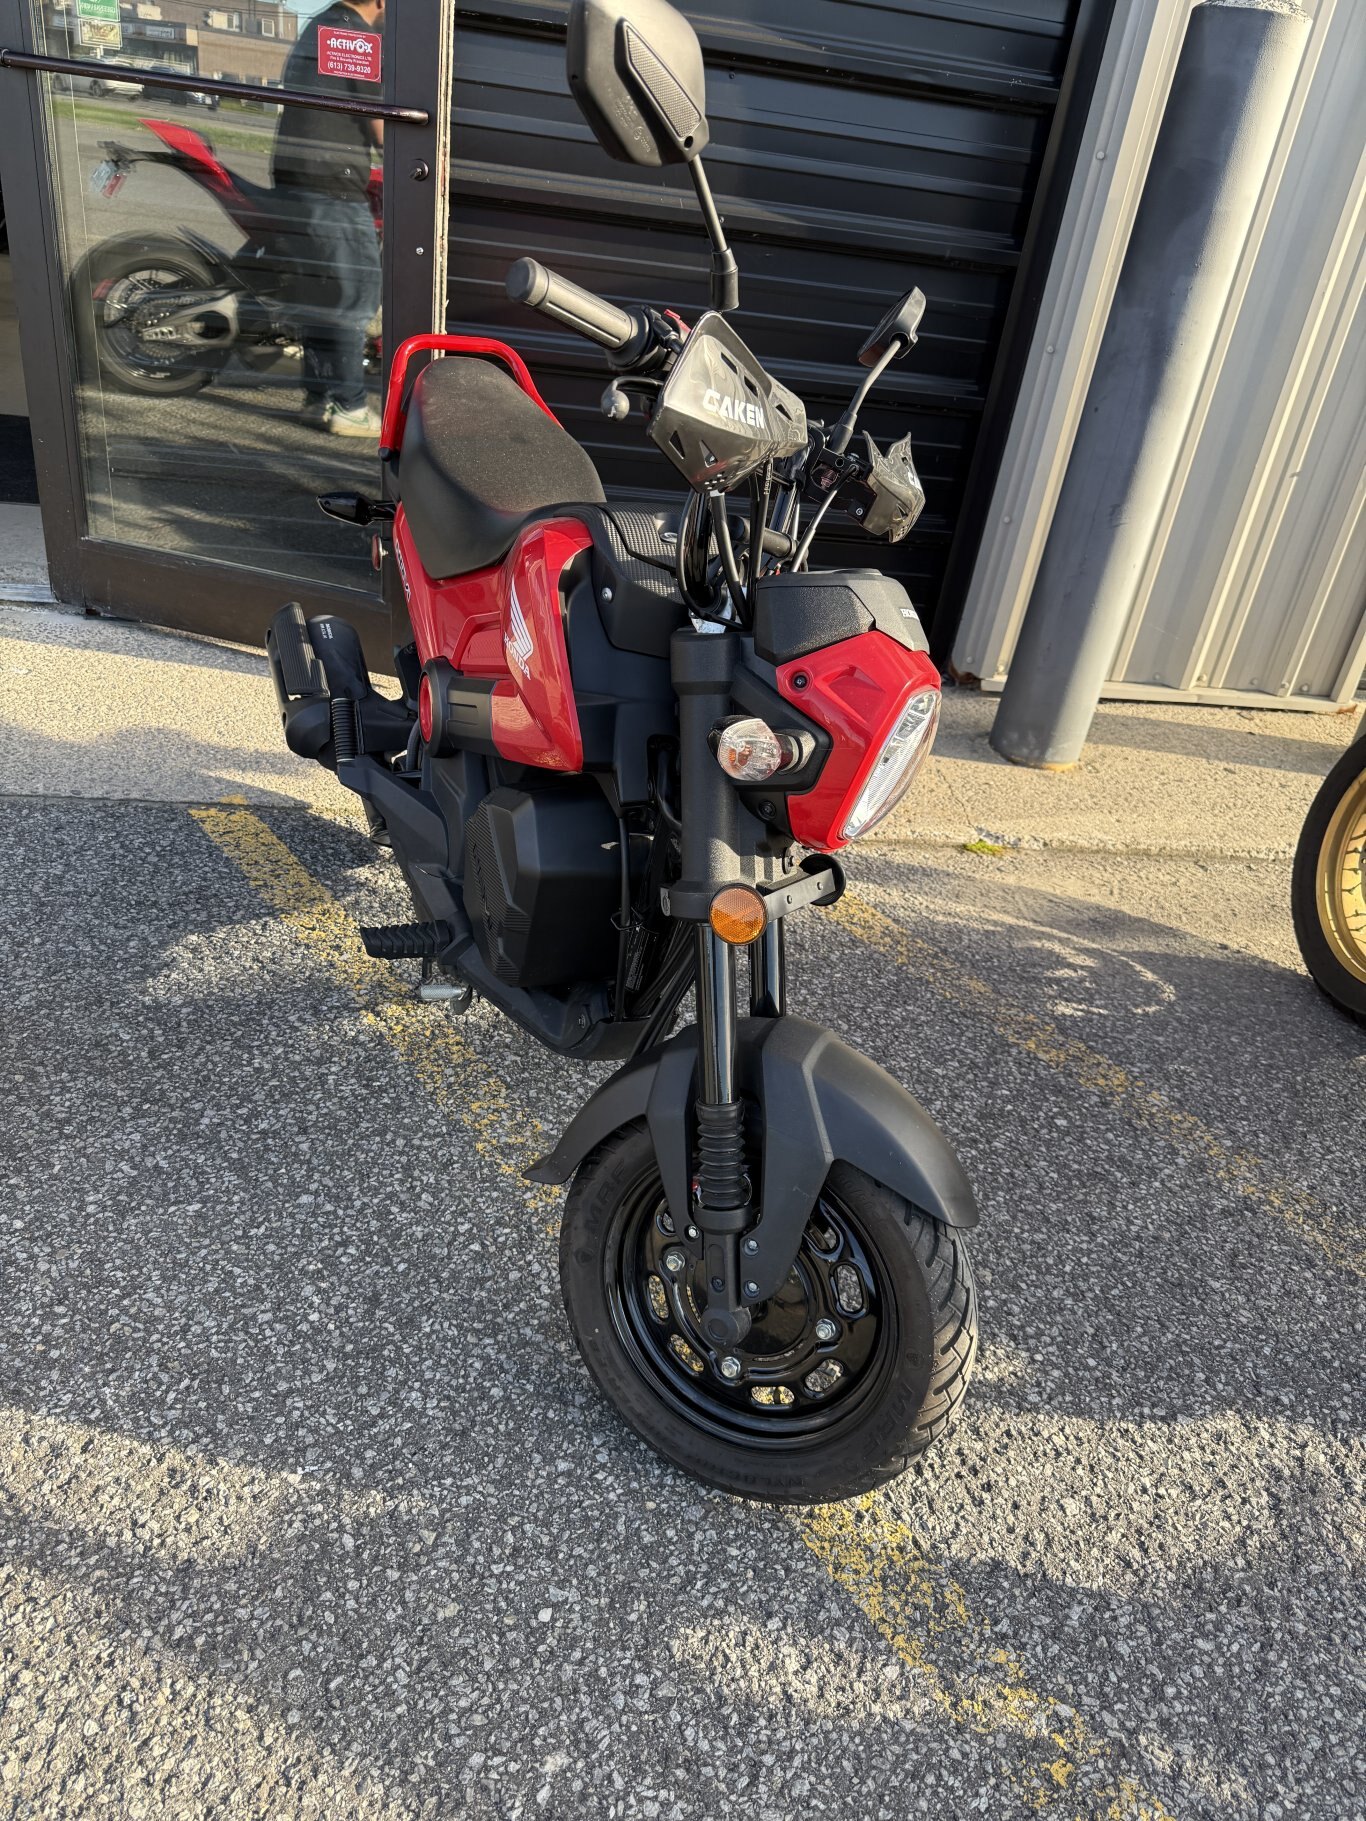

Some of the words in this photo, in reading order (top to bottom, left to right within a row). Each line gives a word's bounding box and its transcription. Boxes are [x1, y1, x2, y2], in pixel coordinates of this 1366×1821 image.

[327, 61, 343, 71] (613)
[344, 63, 371, 74] 739-9320
[900, 607, 920, 621] HON
[503, 631, 532, 681] HONDA
